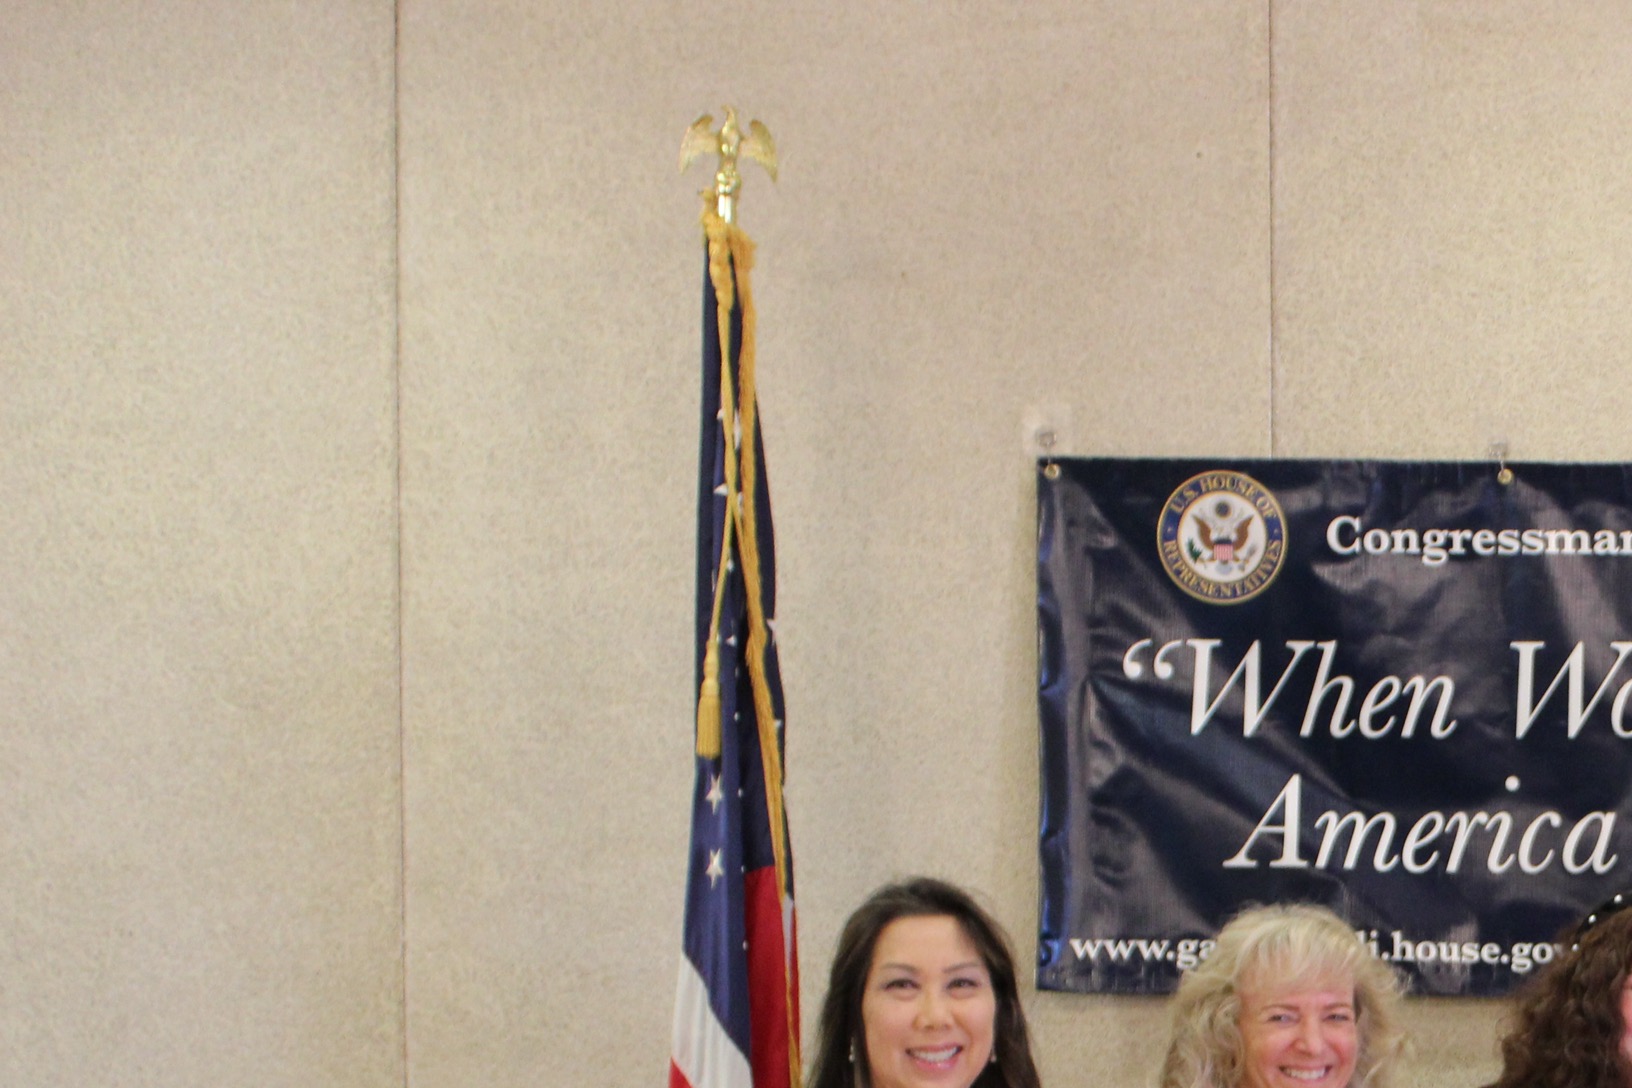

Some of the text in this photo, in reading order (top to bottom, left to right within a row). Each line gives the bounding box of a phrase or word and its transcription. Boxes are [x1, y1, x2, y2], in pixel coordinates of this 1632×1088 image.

[1199, 476, 1255, 497] HOUSE
[1255, 495, 1279, 518] OF
[1122, 638, 1458, 739] “When
[1222, 773, 1619, 874] America
